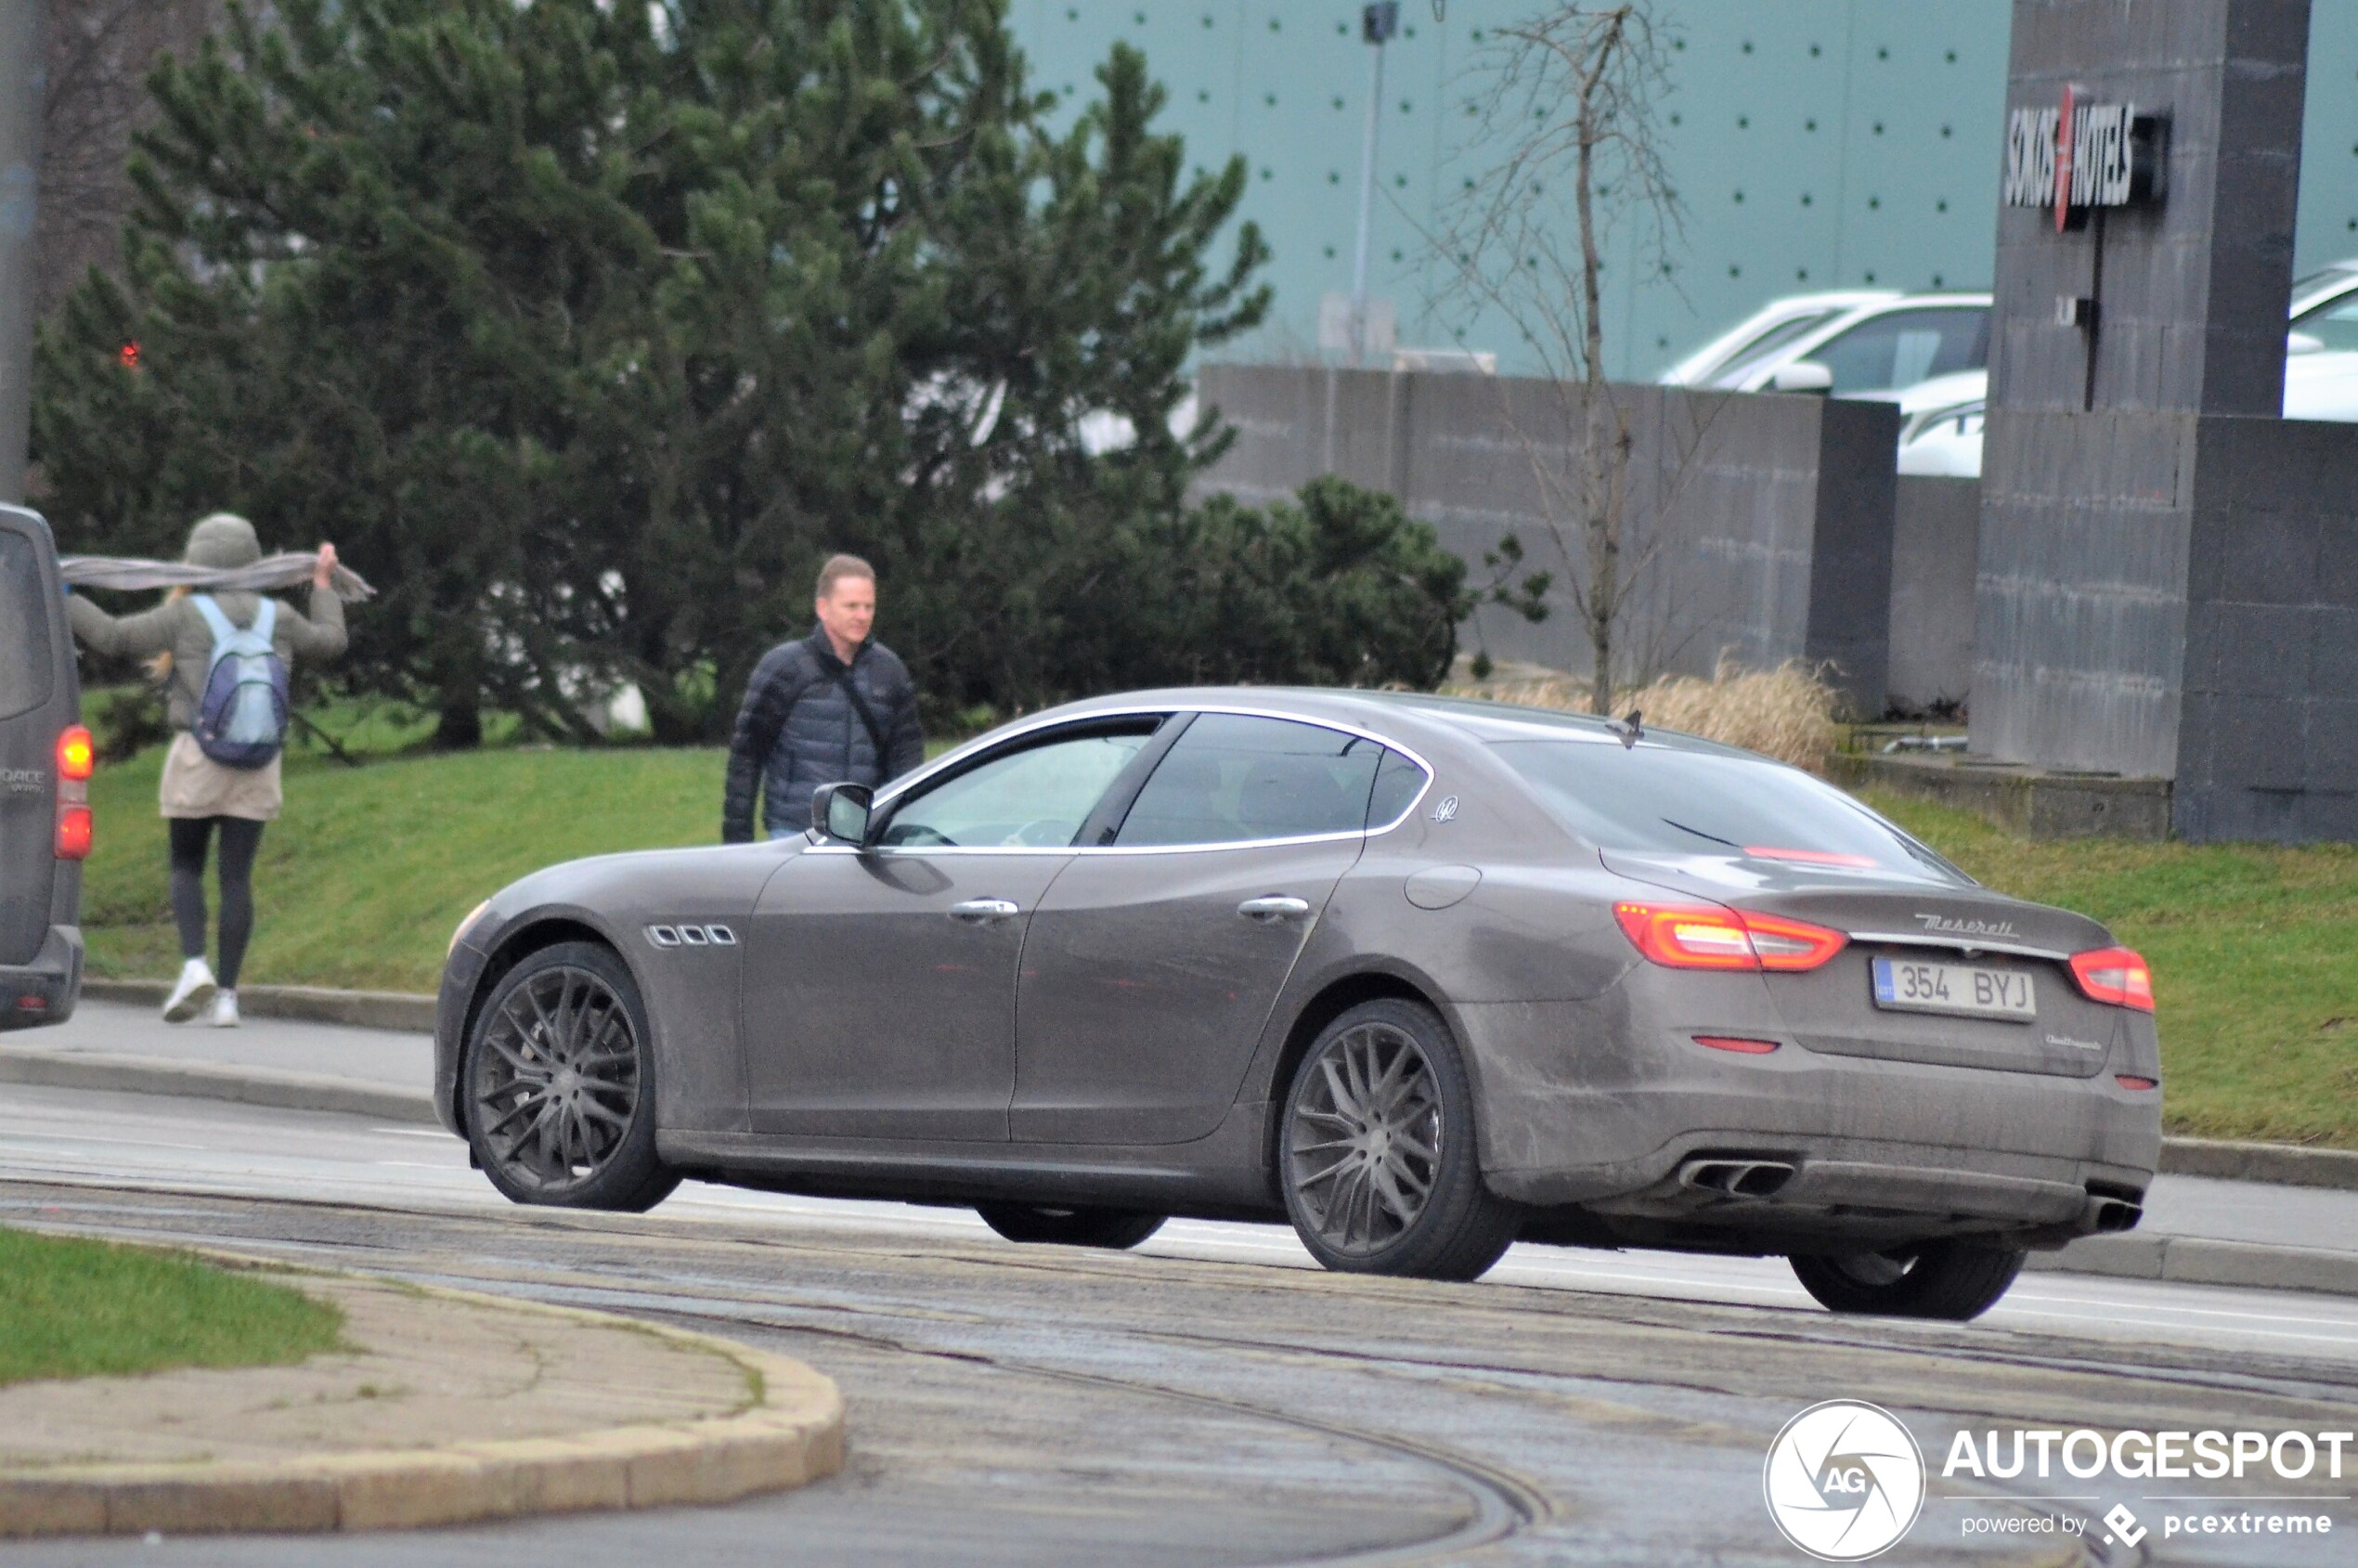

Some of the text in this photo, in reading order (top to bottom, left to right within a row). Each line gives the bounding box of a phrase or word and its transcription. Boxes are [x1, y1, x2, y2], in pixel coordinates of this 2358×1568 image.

[2071, 103, 2134, 206] HOTELS
[1915, 914, 2020, 939] Maserati
[1901, 965, 2027, 1008] 354 BYJ
